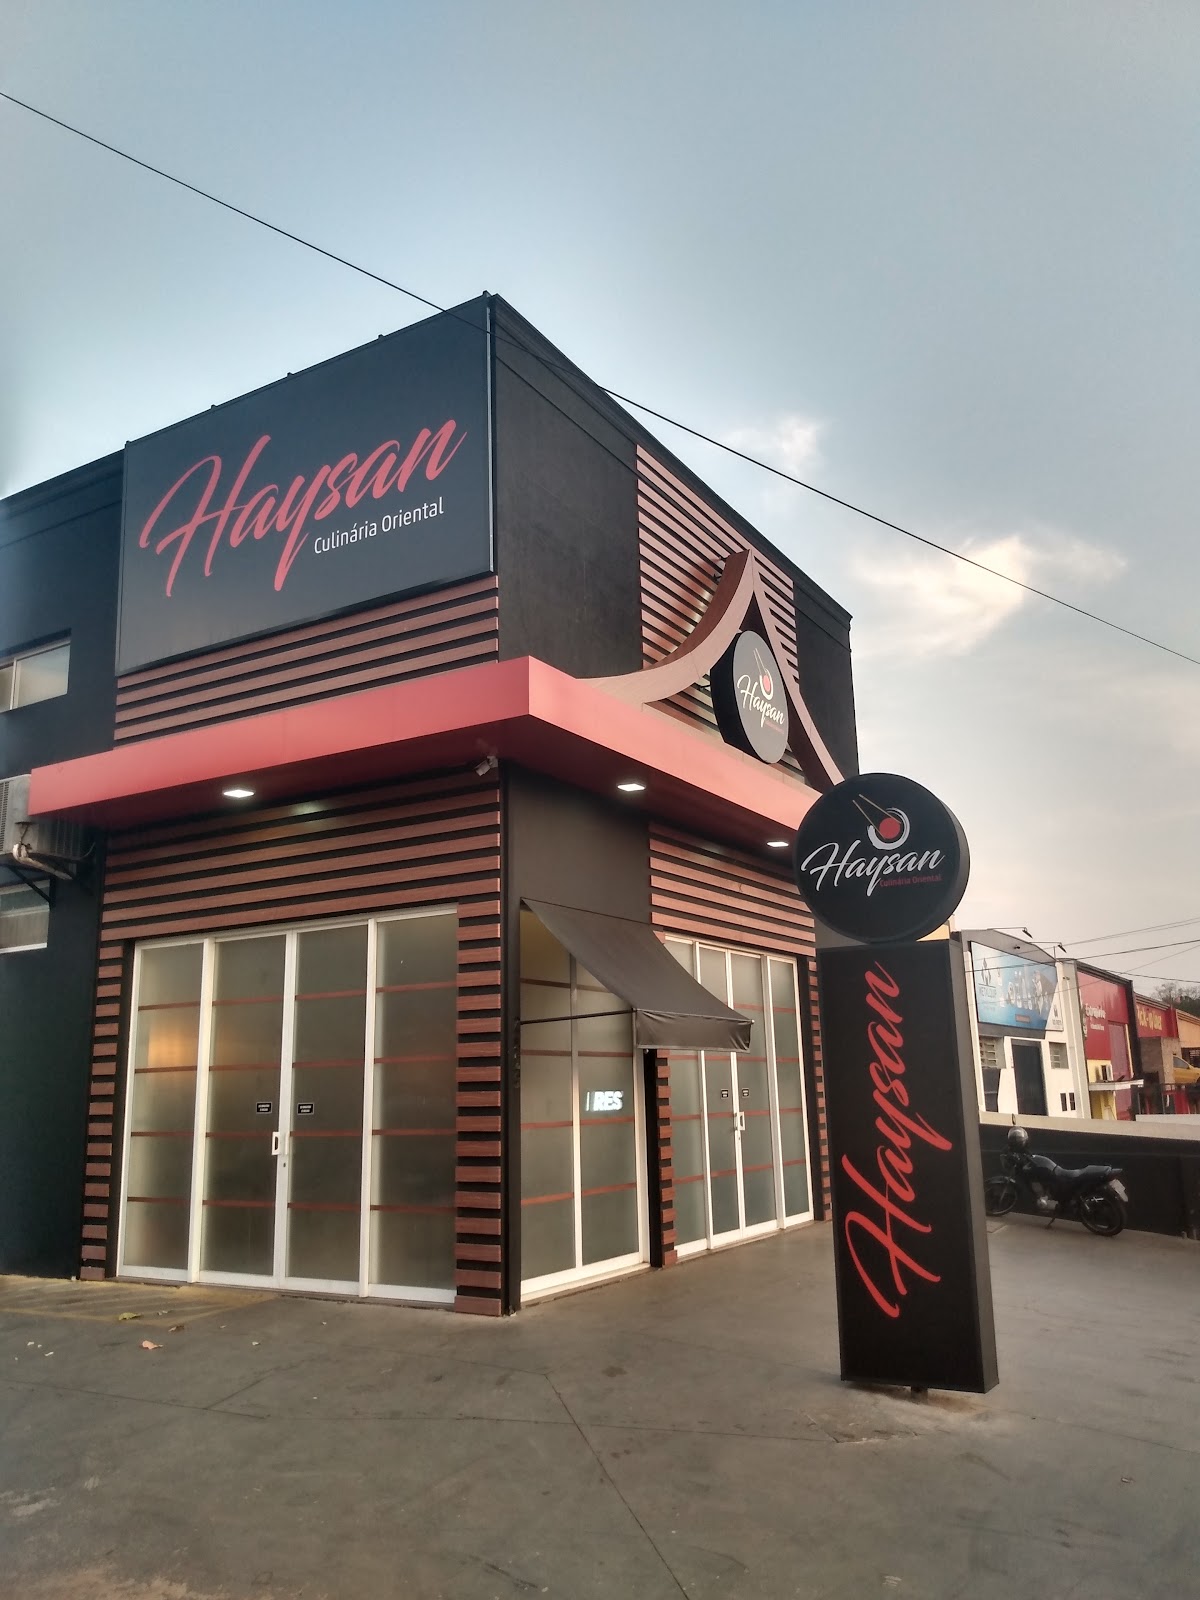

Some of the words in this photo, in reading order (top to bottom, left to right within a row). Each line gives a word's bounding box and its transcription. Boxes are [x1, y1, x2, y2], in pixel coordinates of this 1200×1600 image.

[139, 419, 468, 598] Haysan
[314, 522, 377, 554] Culinária
[381, 496, 444, 532] Oriental
[737, 674, 785, 728] Haysan
[801, 839, 944, 897] Haysan
[841, 960, 953, 1319] Haysan
